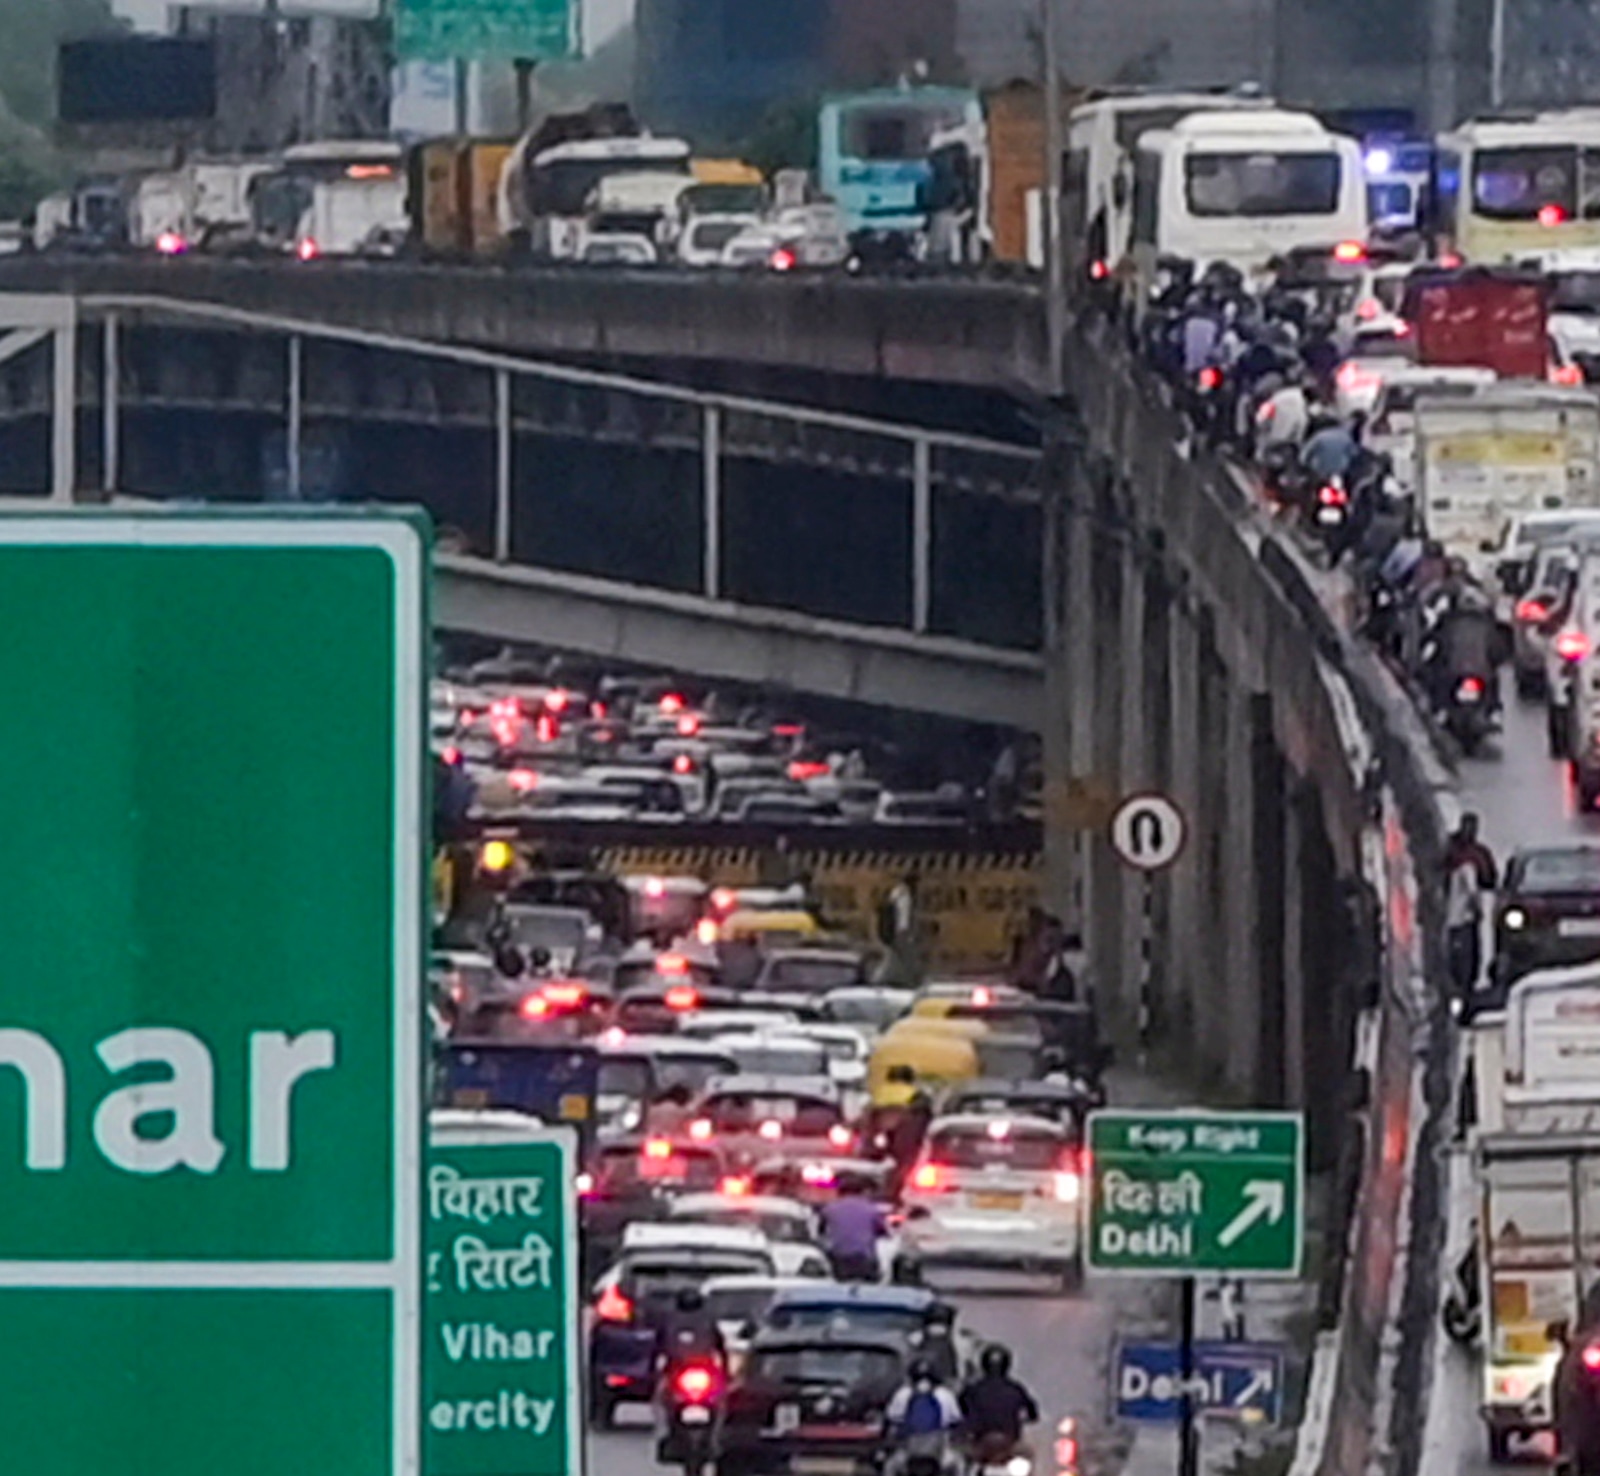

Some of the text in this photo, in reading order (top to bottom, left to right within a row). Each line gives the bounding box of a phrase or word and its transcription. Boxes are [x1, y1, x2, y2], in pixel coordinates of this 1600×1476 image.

[1127, 1124, 1261, 1154] Keep Right
[428, 1163, 544, 1224] विहार
[1100, 1222, 1192, 1256] Delhi
[453, 1232, 553, 1292] सिटी
[441, 1322, 554, 1361] Vihar
[429, 1389, 555, 1435] ercity
